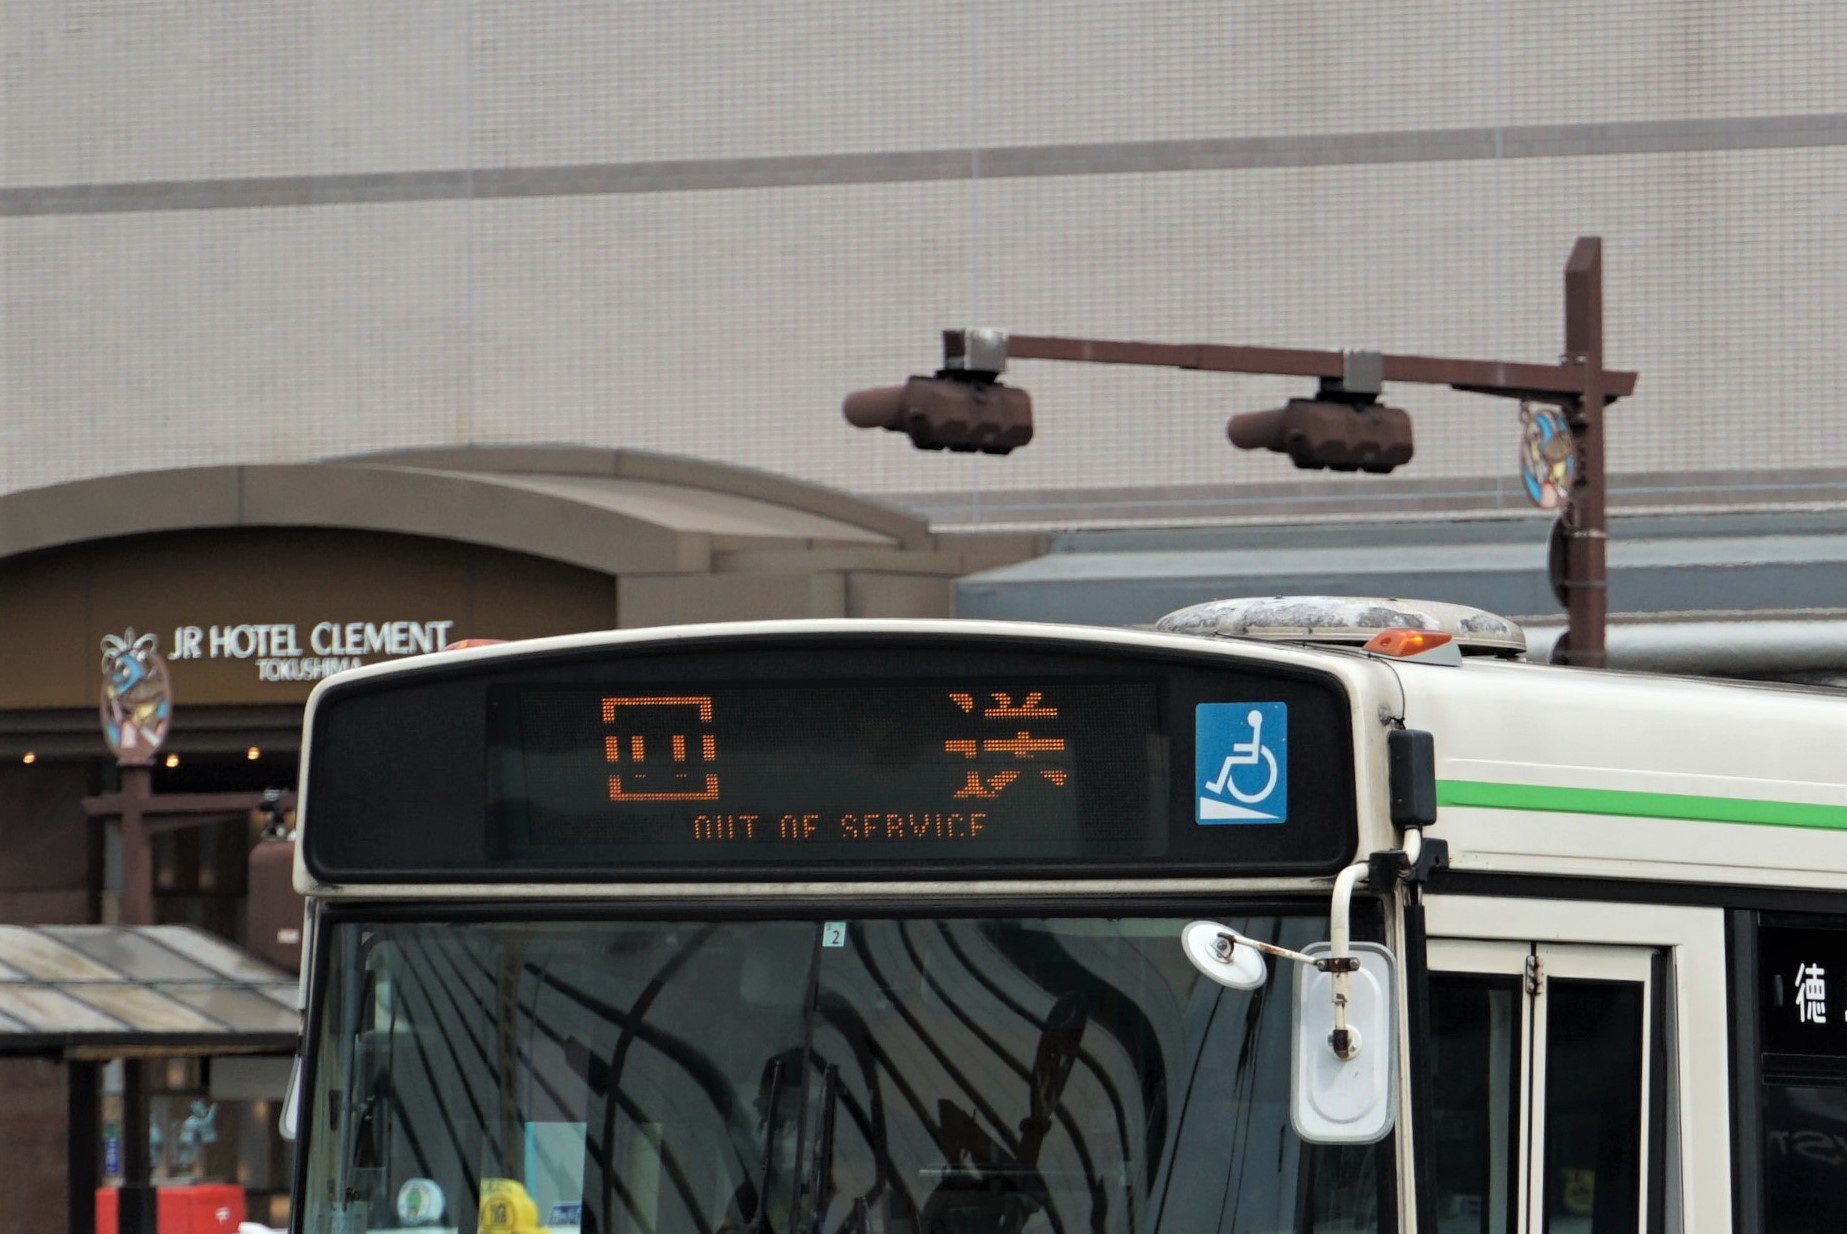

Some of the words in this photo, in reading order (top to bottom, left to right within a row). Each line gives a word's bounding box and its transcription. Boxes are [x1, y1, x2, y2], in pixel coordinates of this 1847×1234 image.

[169, 626, 203, 660] JR
[209, 623, 304, 659] HOTEL
[310, 620, 454, 656] CLEMENT
[694, 814, 759, 839] OUT
[780, 814, 819, 839] OF
[840, 812, 987, 838] SERVICE
